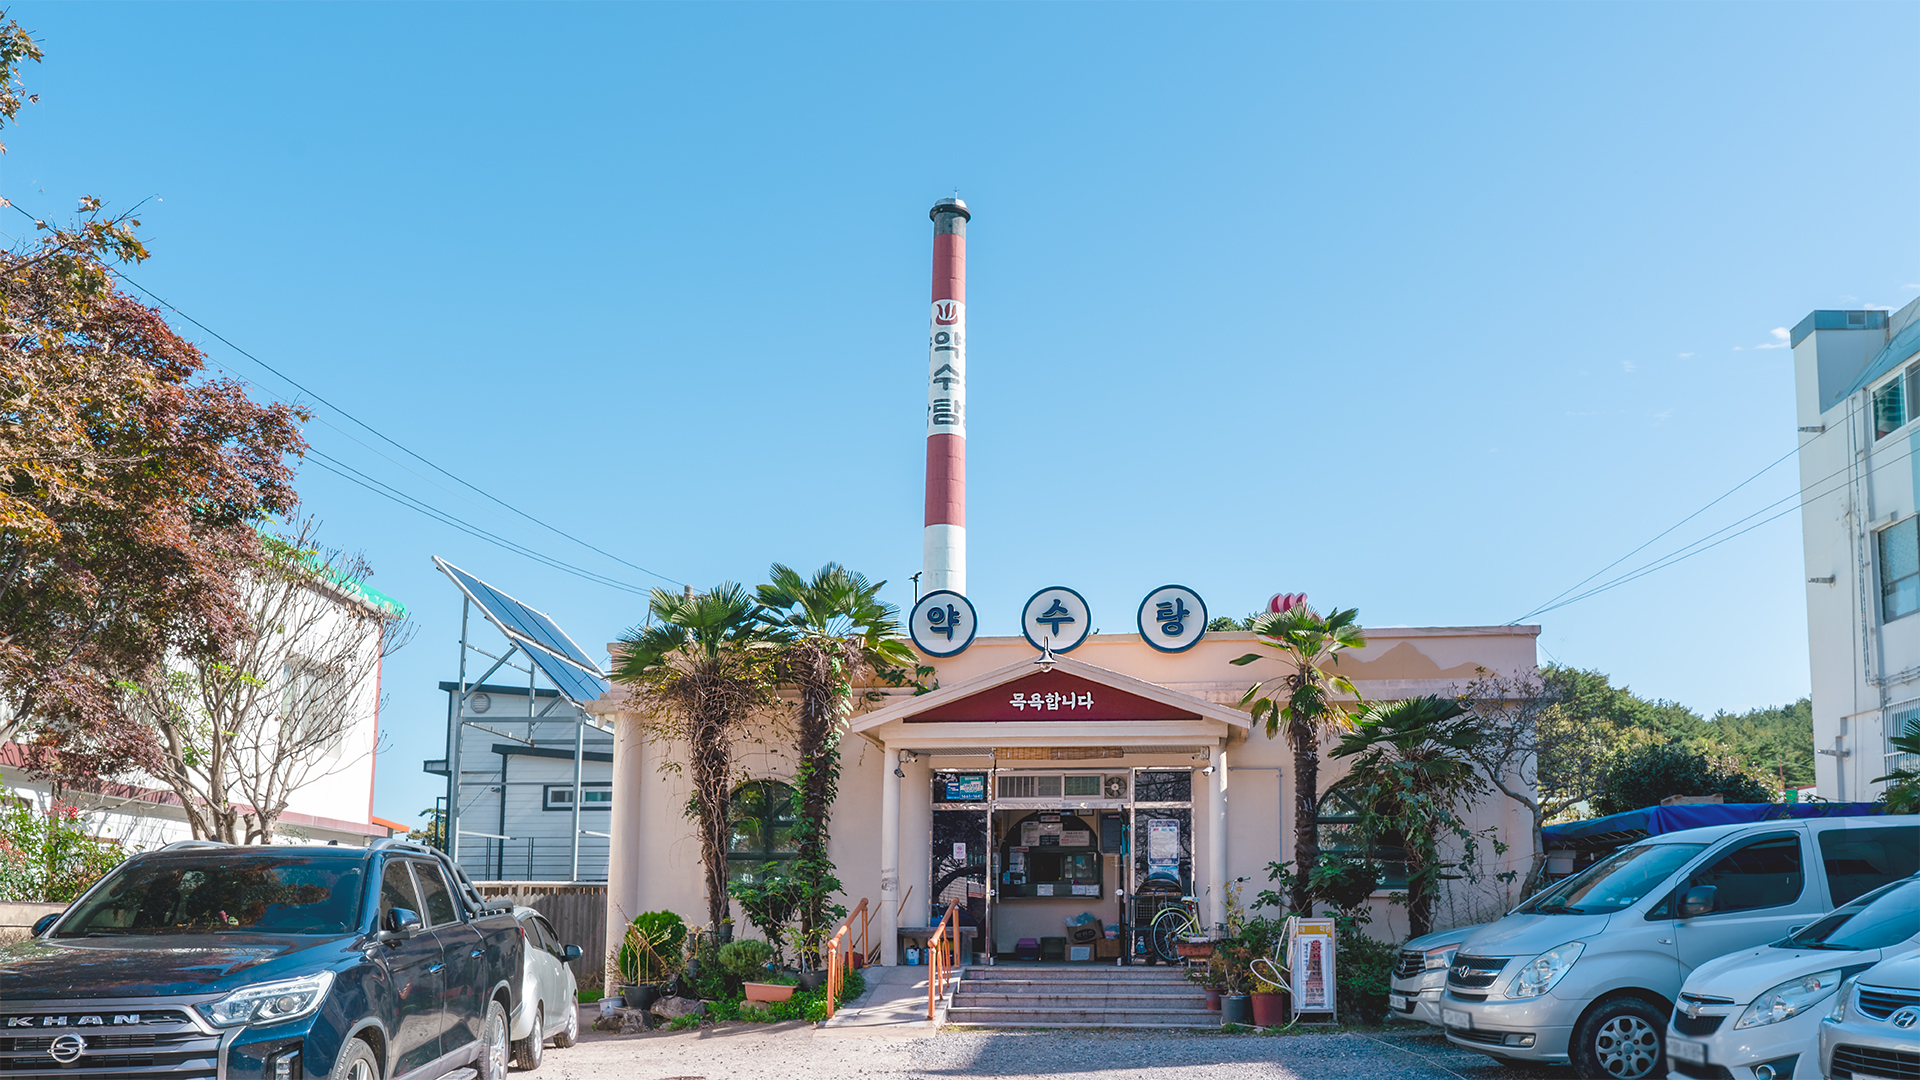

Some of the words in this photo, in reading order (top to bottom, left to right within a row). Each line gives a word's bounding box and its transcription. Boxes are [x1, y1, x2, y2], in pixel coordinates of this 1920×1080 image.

[933, 331, 961, 425] 약수탕
[1009, 691, 1094, 711] 목욕합니다
[8, 1014, 140, 1026] KHAN
